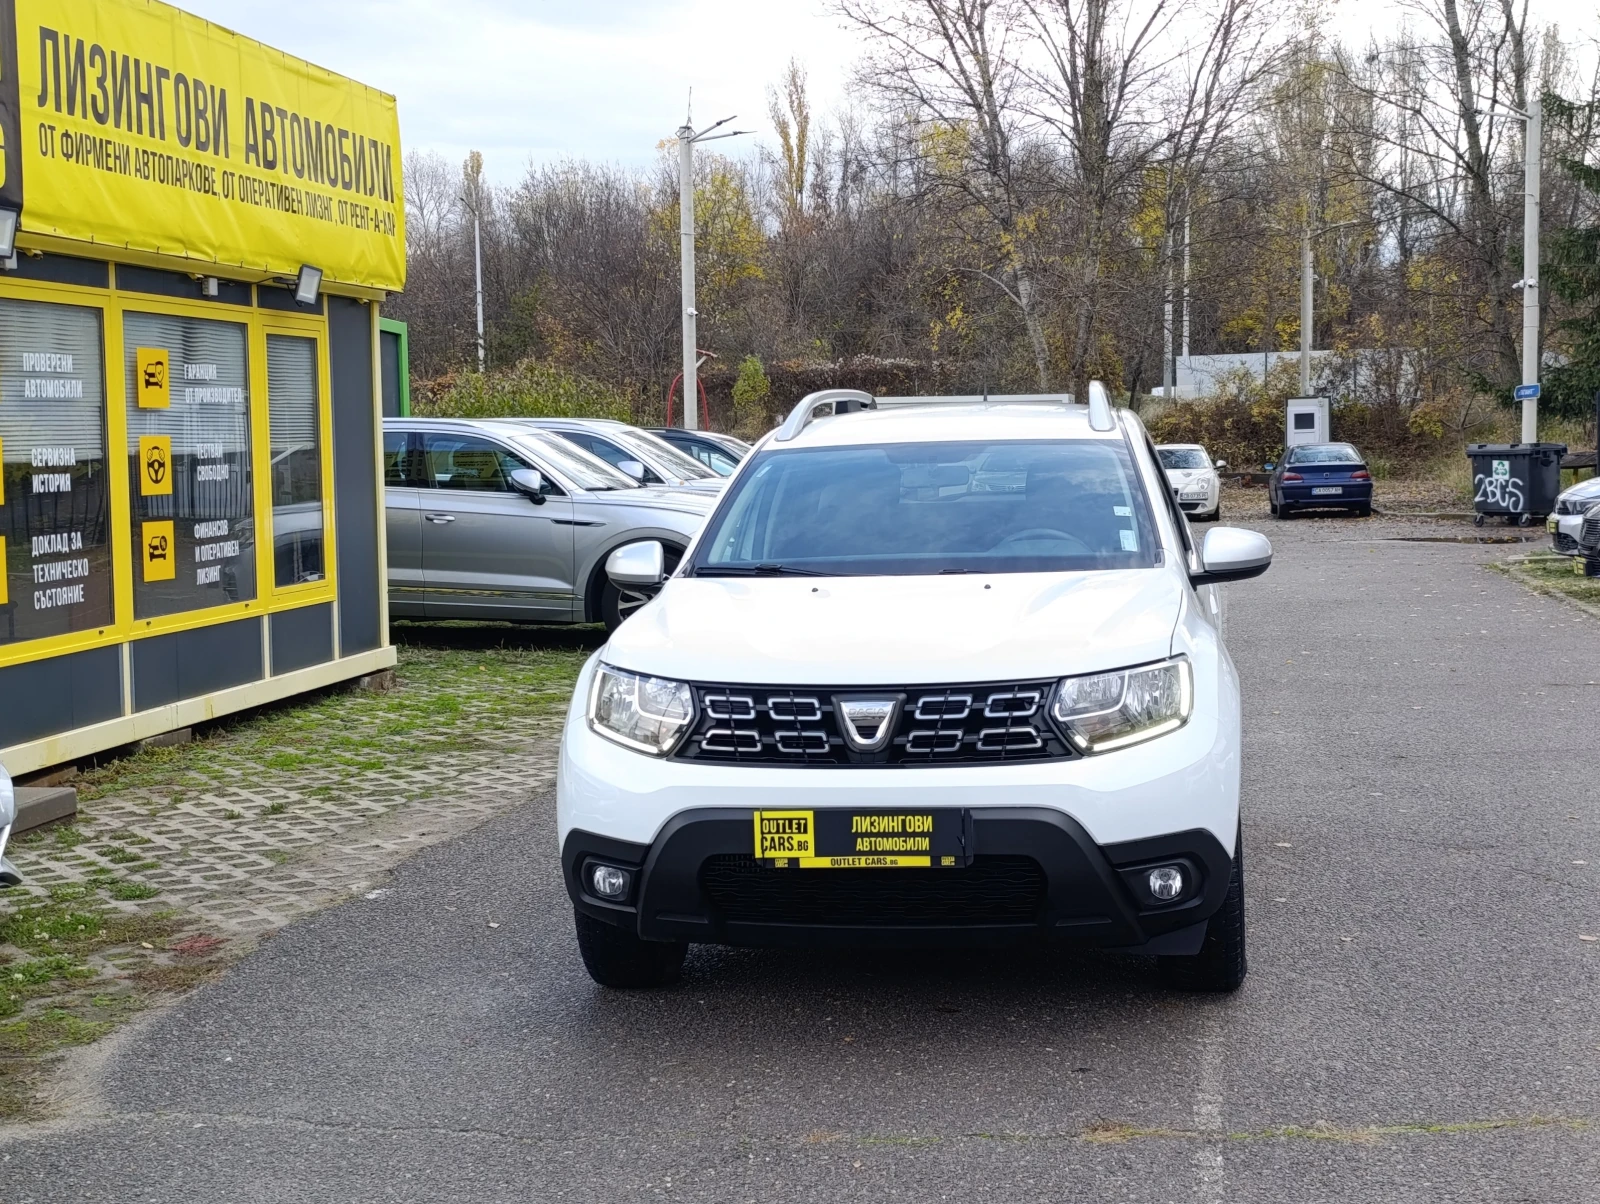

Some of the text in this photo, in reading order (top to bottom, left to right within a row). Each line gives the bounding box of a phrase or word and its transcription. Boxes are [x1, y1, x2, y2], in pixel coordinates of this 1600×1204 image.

[38, 26, 229, 159] ЛИЗИНГОВИ
[245, 97, 394, 203] АВТОМОБИЛИ
[39, 123, 56, 158] ОТ
[60, 129, 131, 176] ФИРМЕНИ
[134, 148, 220, 201] АВТОПАРКОВЕ,
[222, 170, 235, 200] ОТ
[238, 174, 304, 215] ОПЕРАТИВЕН
[338, 199, 348, 226] ОТ
[23, 353, 73, 372] ПРОВЕРЕНИ
[184, 364, 217, 381] ГАРАНЦИЯ
[25, 379, 83, 398] АВТОМОБИЛИ
[185, 388, 194, 403] ОТ
[32, 448, 76, 467] СЕРВИЗНА
[197, 441, 223, 459] ТЕСТВАЙ
[197, 464, 229, 481] СВОБОДНО
[32, 473, 71, 493] ИСТОРИЯ
[194, 519, 229, 539] ФИНАНСОВ
[32, 531, 82, 557] ДОКЛАД ЗА
[195, 540, 239, 562] И ОПЕРАТИВЕН
[32, 558, 89, 583] ТЕХНИЧЕСКО
[196, 565, 221, 585] ЛИЗИНГ
[34, 584, 84, 610] СЪСТОЯНИЕ
[848, 708, 888, 716] DACIA
[763, 819, 806, 833] OUTLET
[851, 816, 933, 833] ЛИЗИНГОВИ
[762, 836, 809, 852] CARS.BG
[856, 837, 930, 851] АВТОМОБИЛИ
[830, 857, 899, 866] OUTLET CARS.BG
